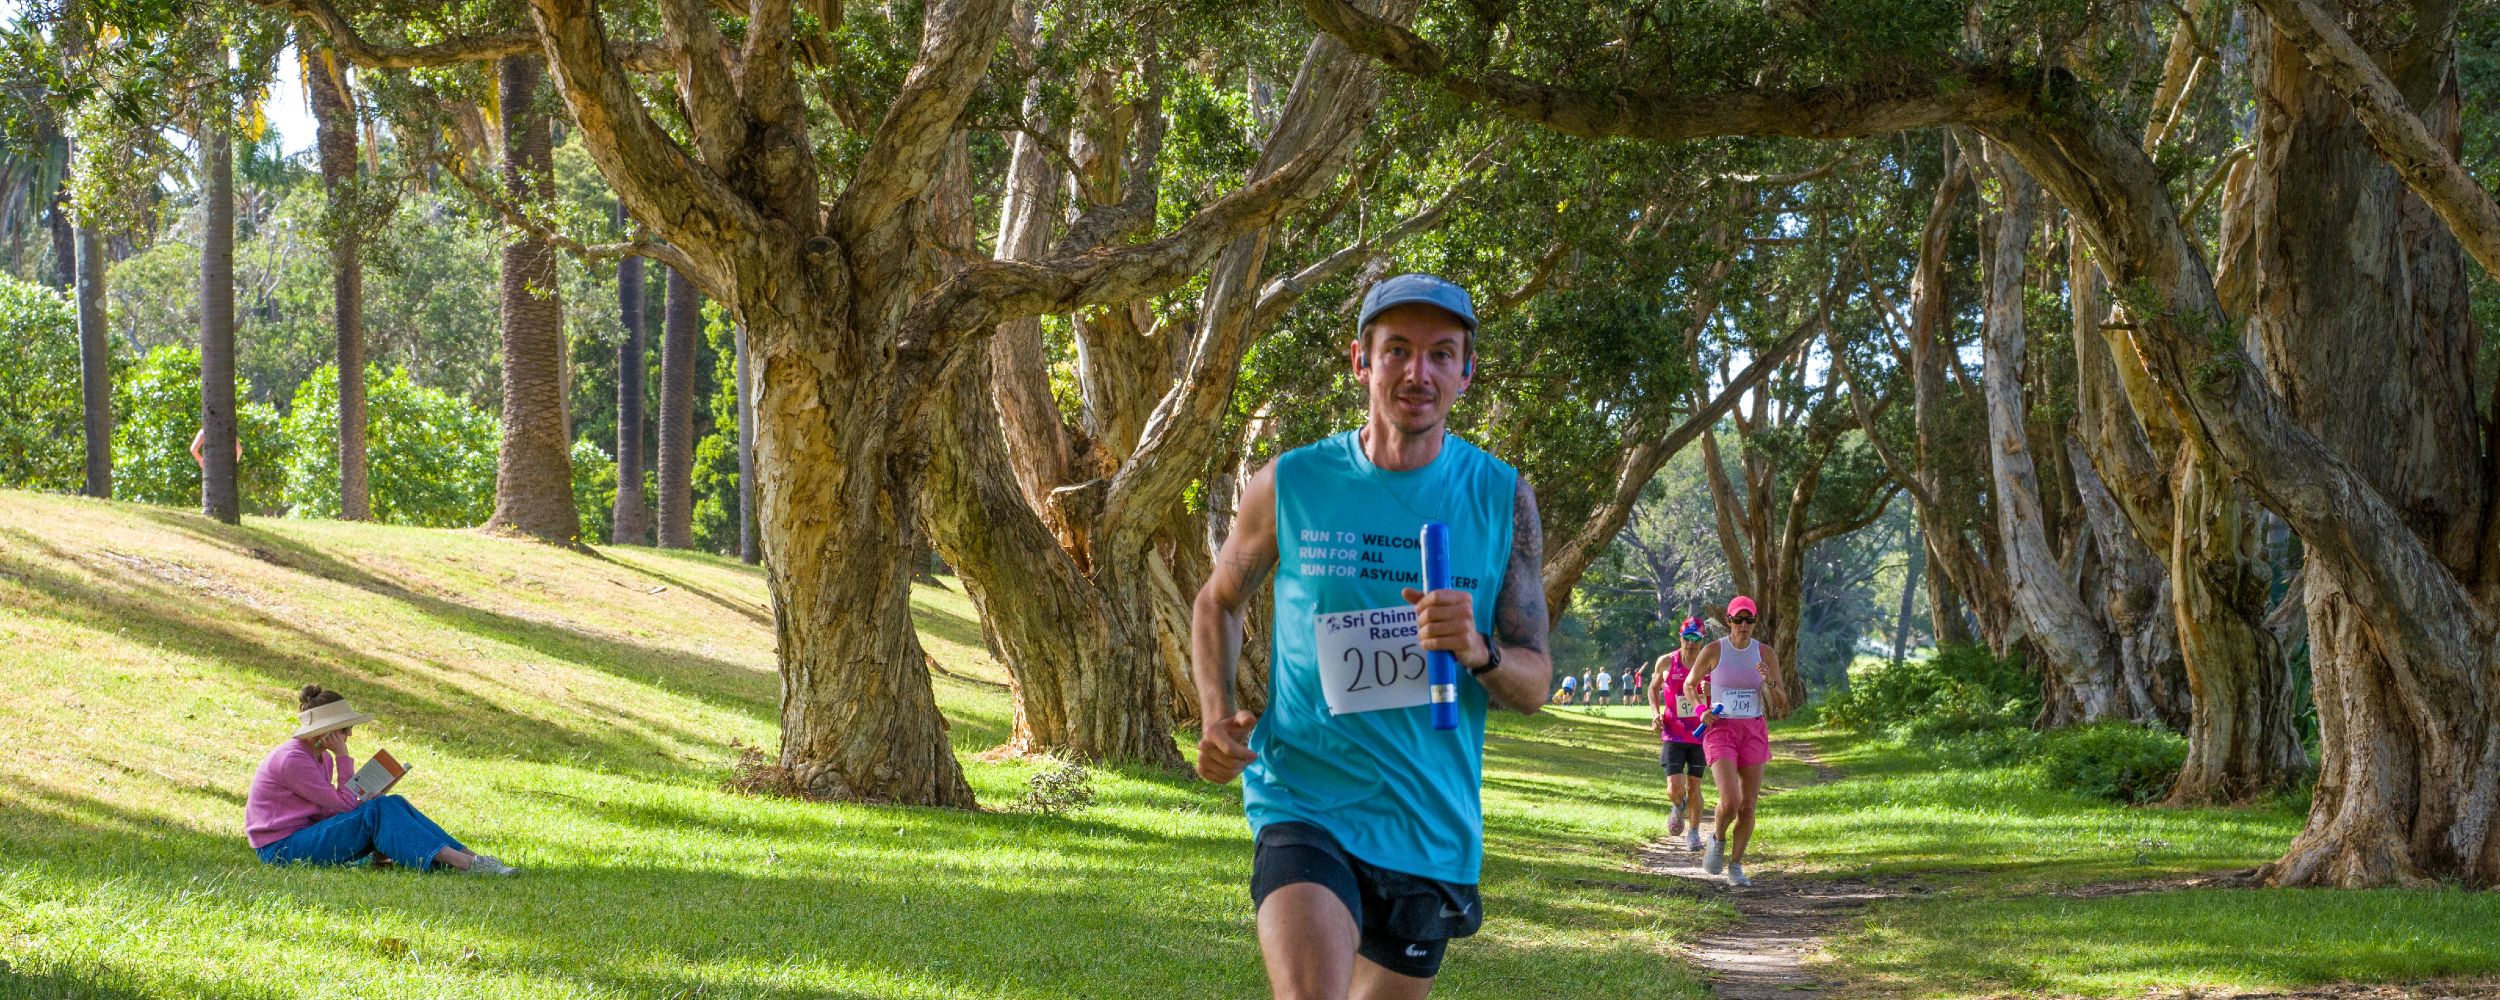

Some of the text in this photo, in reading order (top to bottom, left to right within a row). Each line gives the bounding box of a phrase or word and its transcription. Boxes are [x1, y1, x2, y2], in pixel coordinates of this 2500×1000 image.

[1300, 529, 1422, 550] RUN TO WELCOM
[1300, 547, 1385, 564] RUN FOR ALL
[1300, 564, 1325, 576] RUN
[1328, 565, 1357, 577] FOR
[1359, 567, 1418, 583] ASYLUM
[1343, 614, 1364, 628] Sri
[1370, 625, 1418, 640] Races
[1343, 643, 1426, 692] 205
